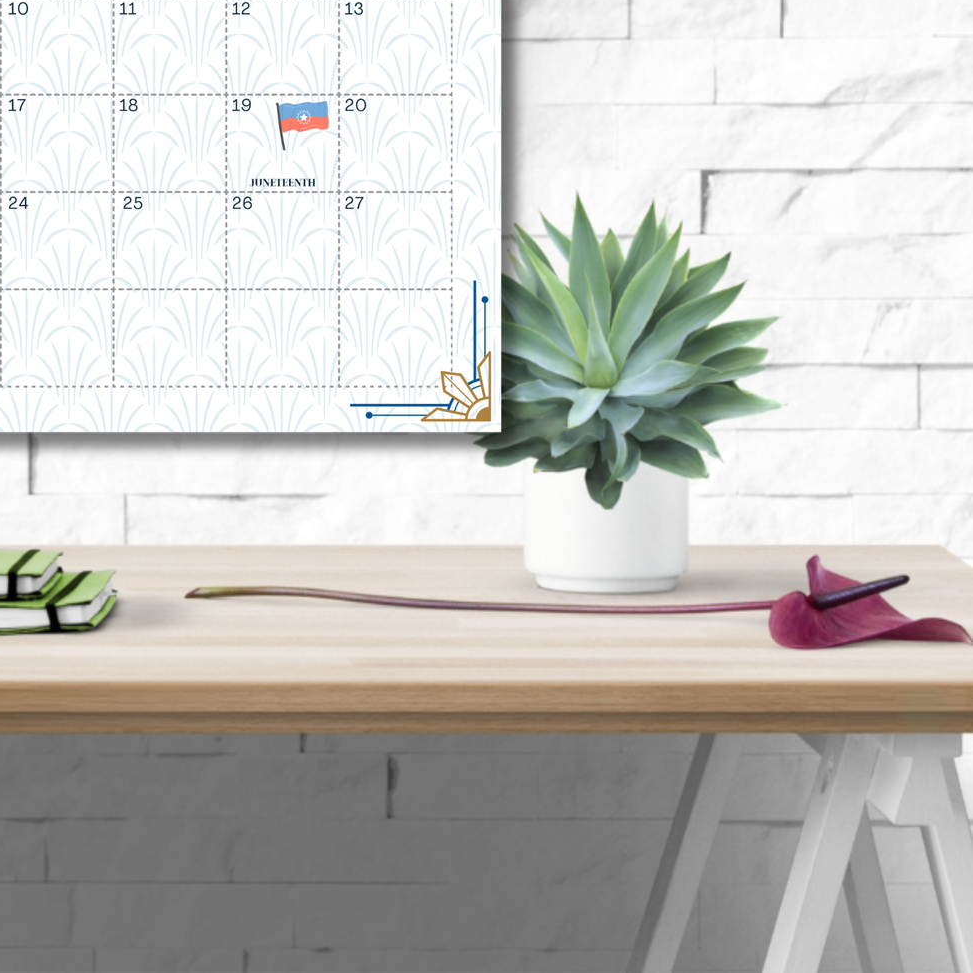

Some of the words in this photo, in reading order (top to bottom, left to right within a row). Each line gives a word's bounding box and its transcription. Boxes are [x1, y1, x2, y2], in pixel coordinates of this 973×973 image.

[8, 1, 29, 16] 10
[119, 1, 137, 16] 11
[231, 1, 251, 16] 12
[344, 1, 364, 16] 13
[8, 98, 27, 112] 17
[119, 98, 139, 112] 18
[231, 98, 252, 112] 19
[344, 98, 367, 112] 20
[249, 177, 317, 188] JUNETEENTH
[8, 195, 29, 210] 24
[123, 195, 143, 210] 25
[232, 195, 253, 210] 26
[344, 195, 365, 210] 27
